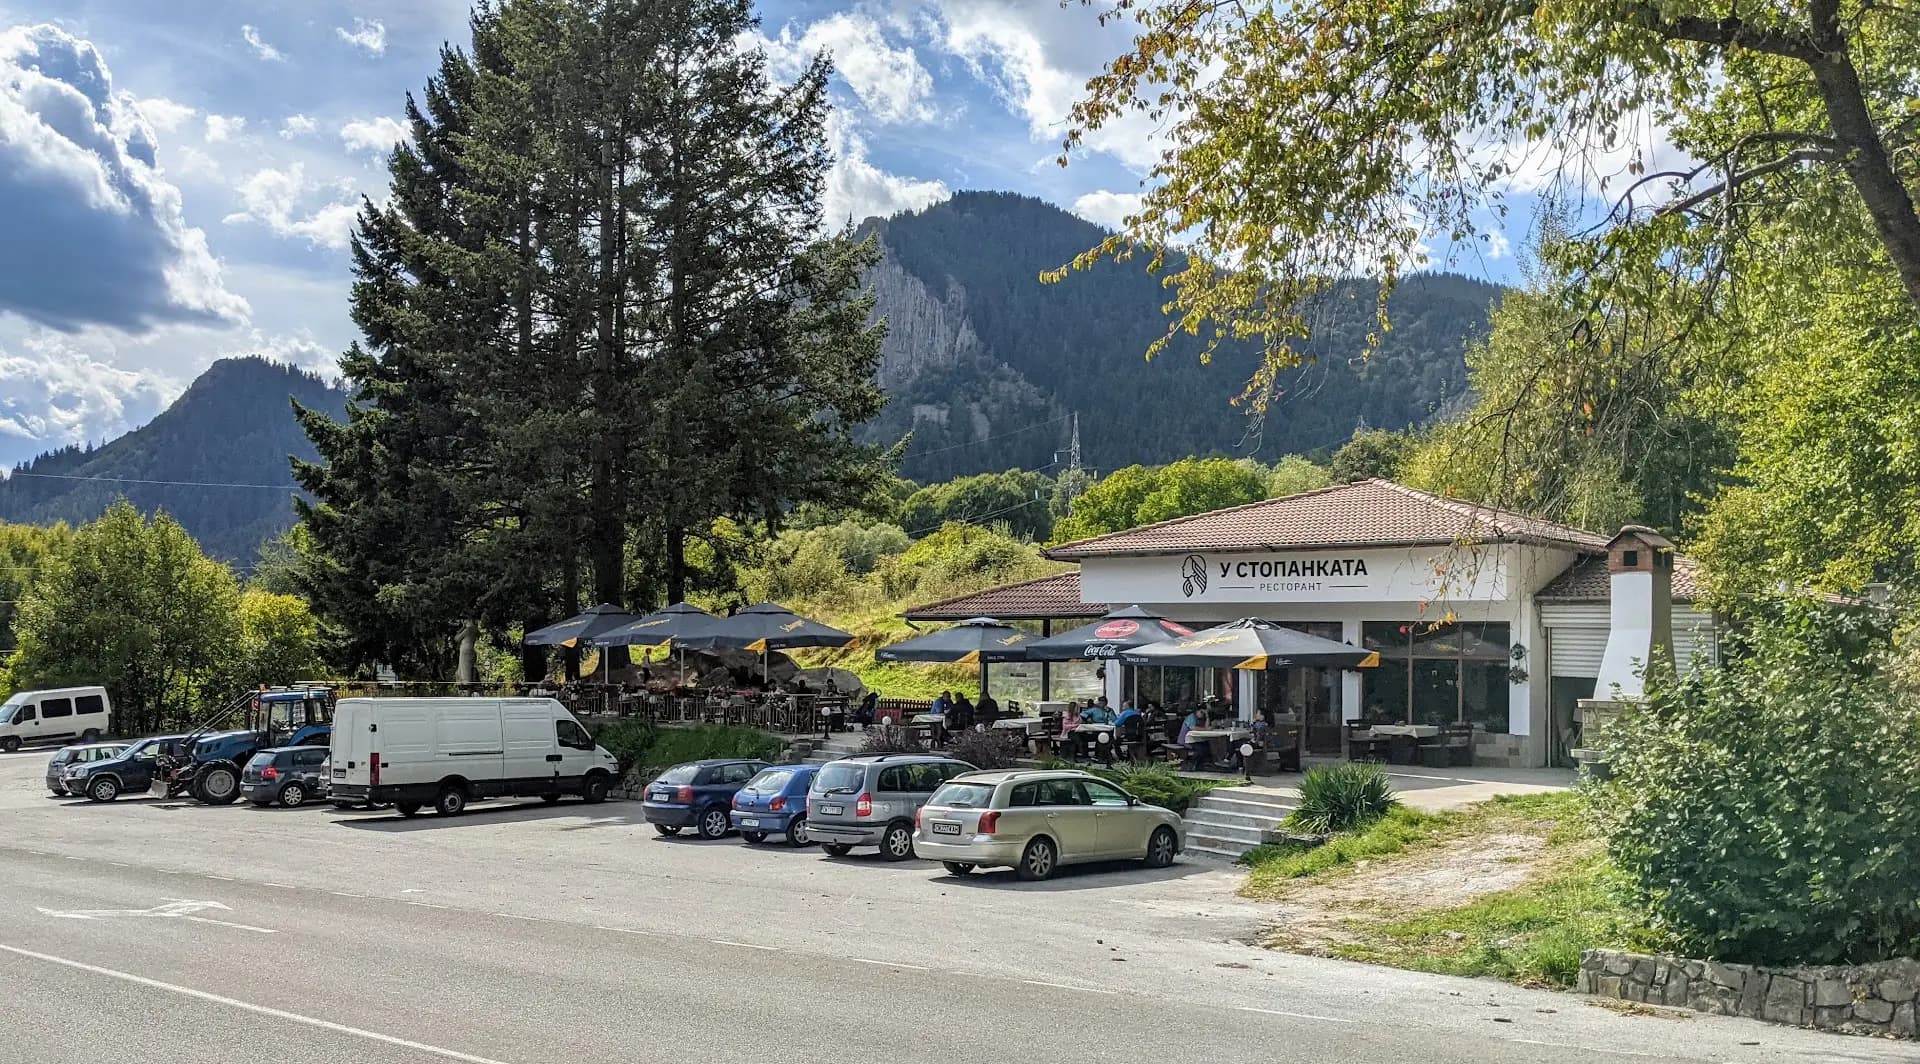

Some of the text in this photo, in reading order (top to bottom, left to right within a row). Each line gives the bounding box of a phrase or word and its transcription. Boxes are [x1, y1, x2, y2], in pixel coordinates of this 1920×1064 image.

[1219, 560, 1368, 578] У СТОПАНКАТА
[1259, 582, 1322, 592] РЕСТОРАНТ
